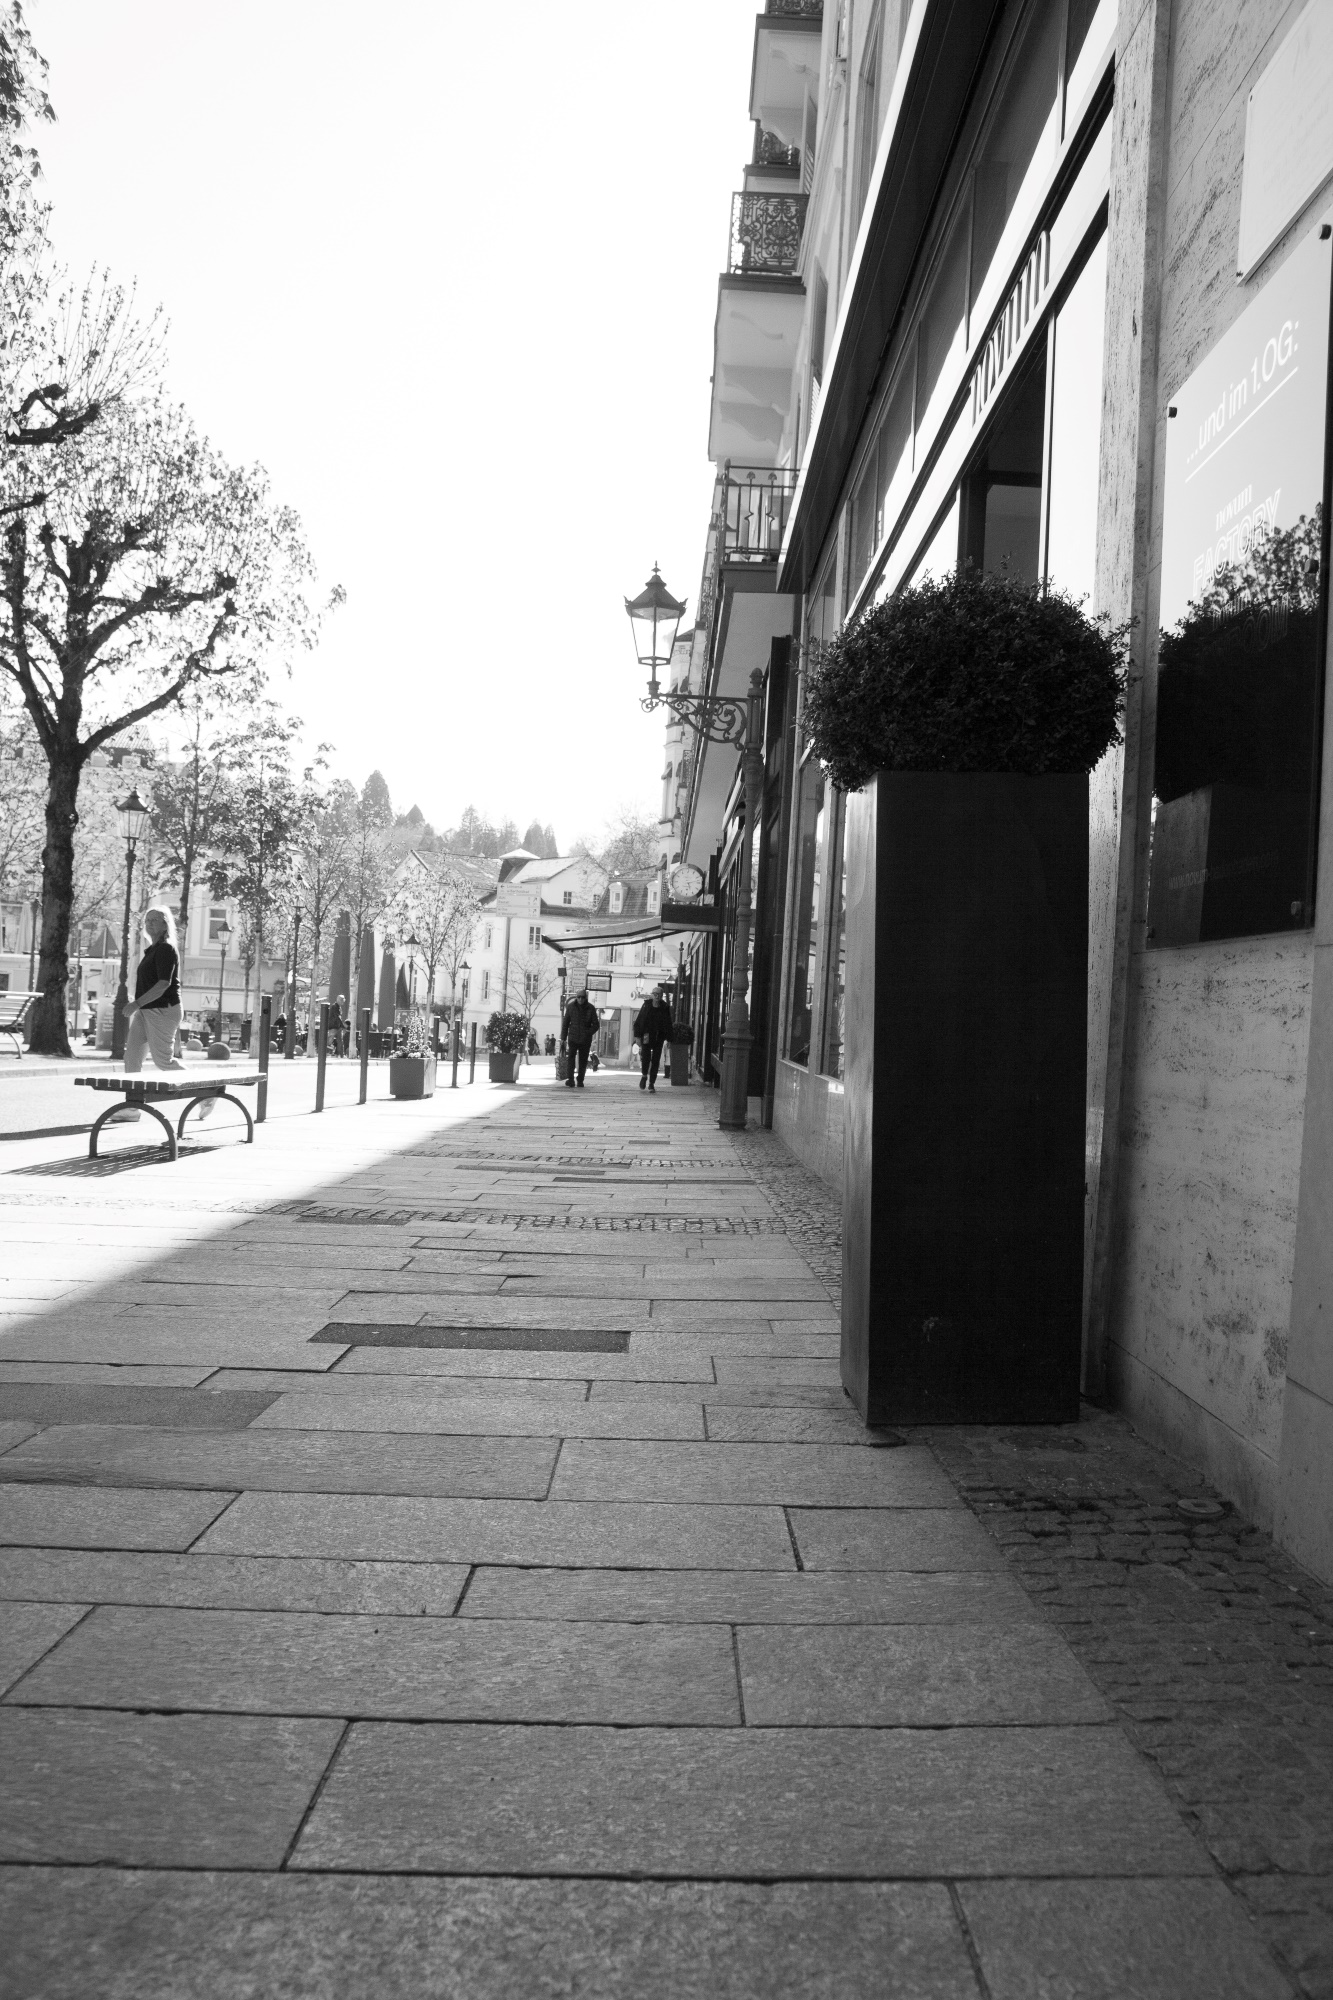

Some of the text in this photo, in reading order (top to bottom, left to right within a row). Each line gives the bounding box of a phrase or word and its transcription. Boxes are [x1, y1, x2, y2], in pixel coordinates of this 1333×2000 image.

[1229, 378, 1247, 420] im
[1251, 319, 1299, 394] 1.OG:
[1193, 488, 1281, 597] FACTORY
[1215, 484, 1253, 532] novum
